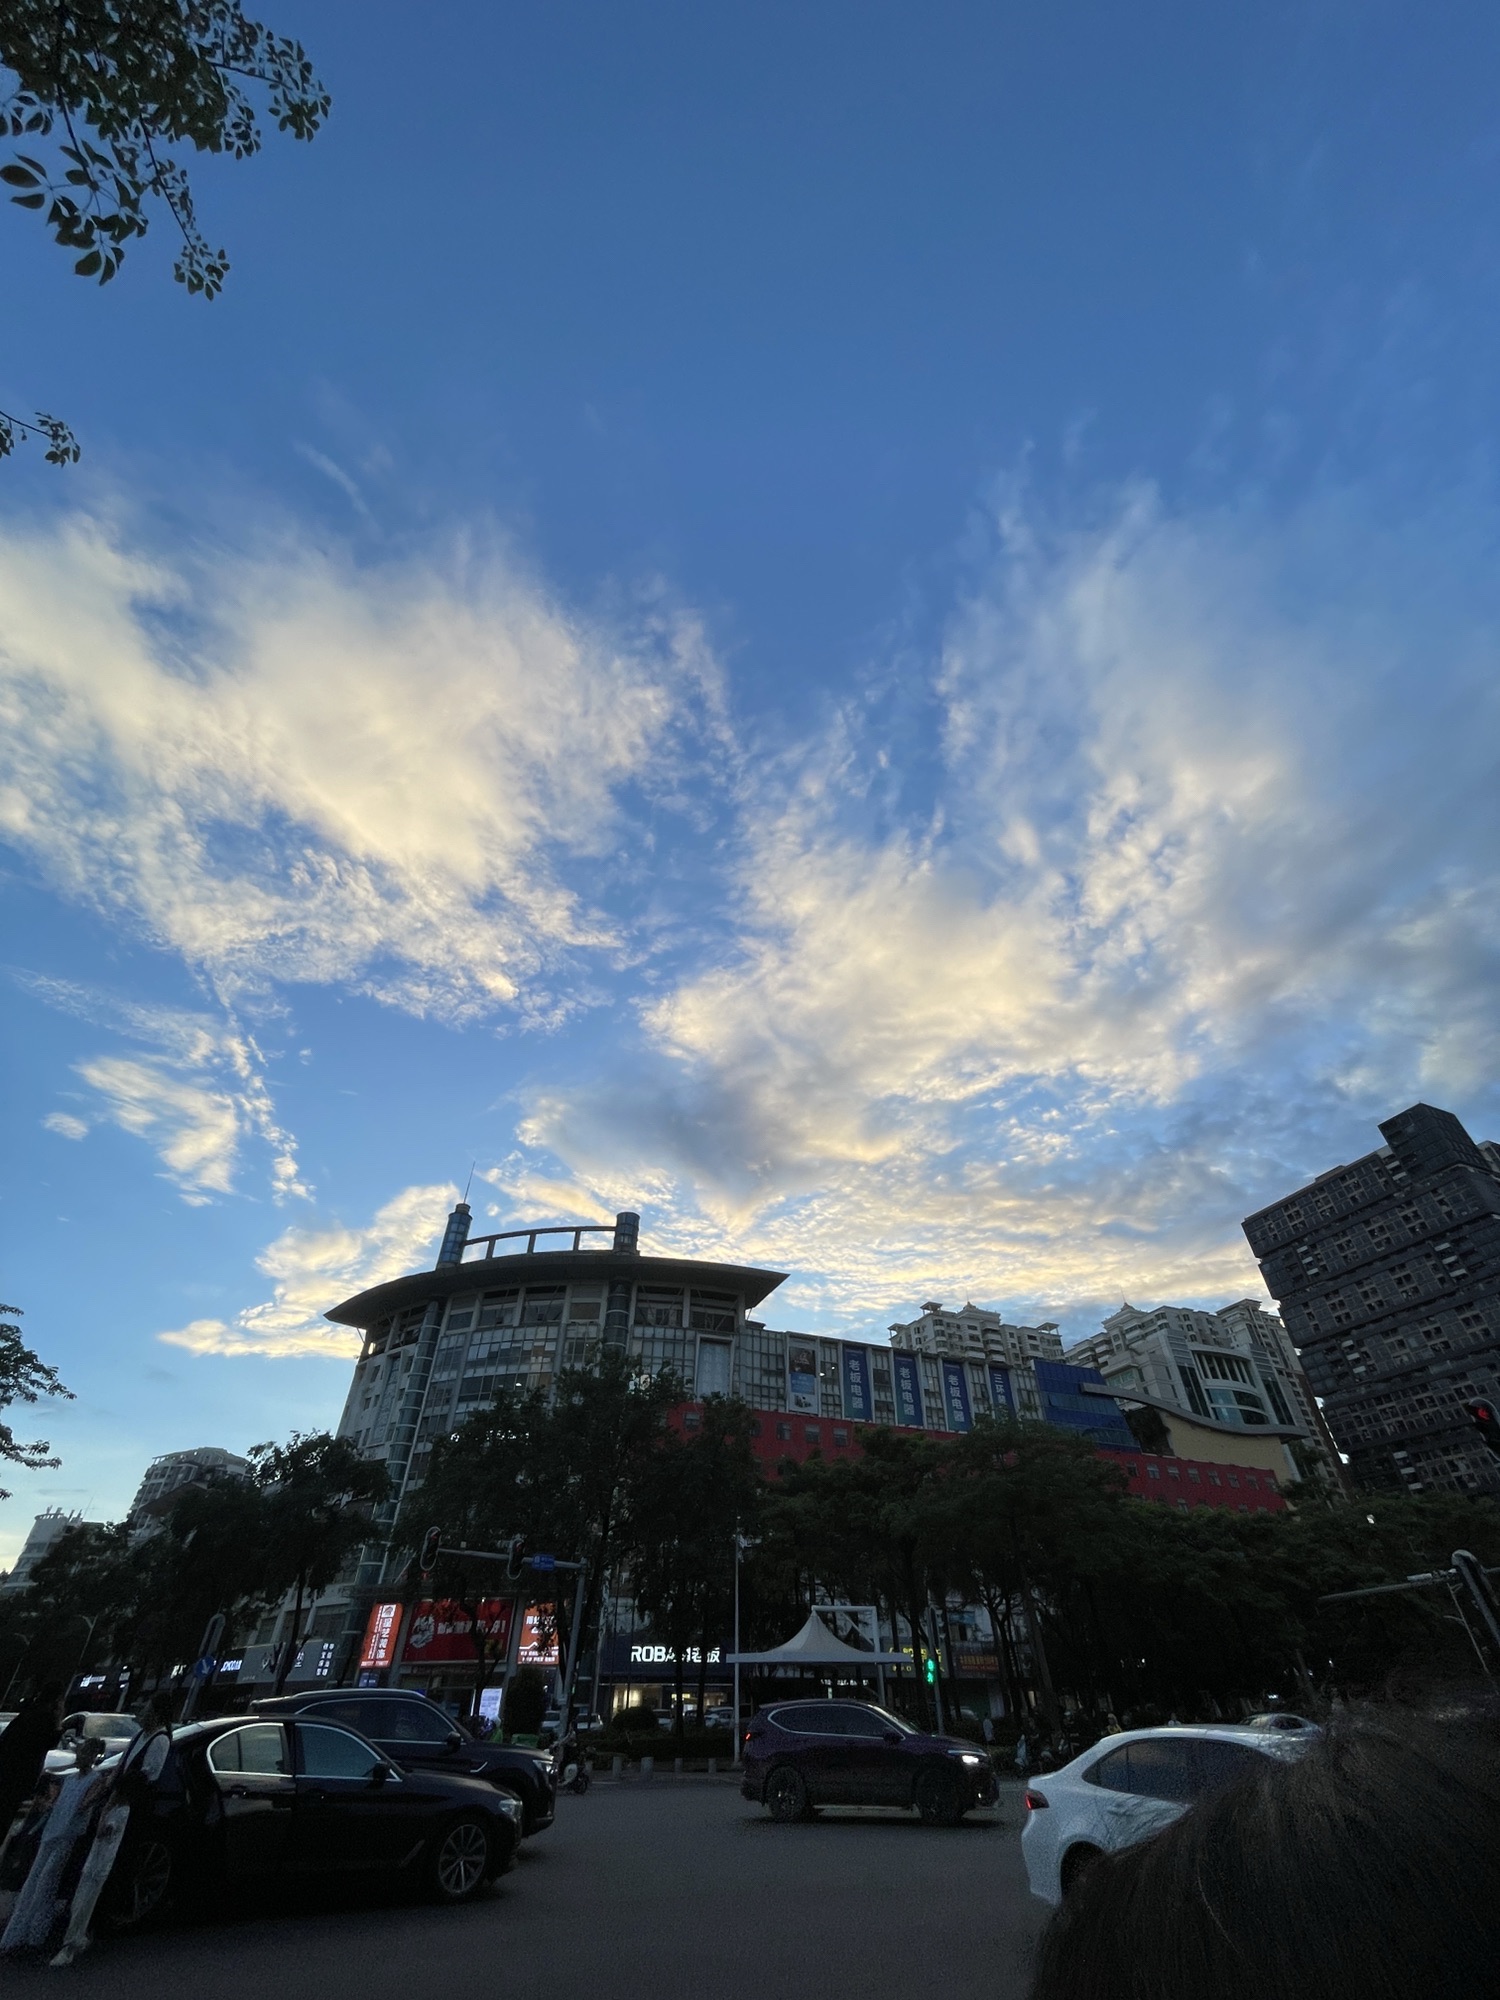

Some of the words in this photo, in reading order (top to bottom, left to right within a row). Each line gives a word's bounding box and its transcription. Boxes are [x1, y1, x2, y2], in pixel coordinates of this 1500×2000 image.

[849, 1359, 864, 1409] 老板电器
[900, 1367, 915, 1416] 老板电器
[948, 1375, 965, 1422] 老板电器
